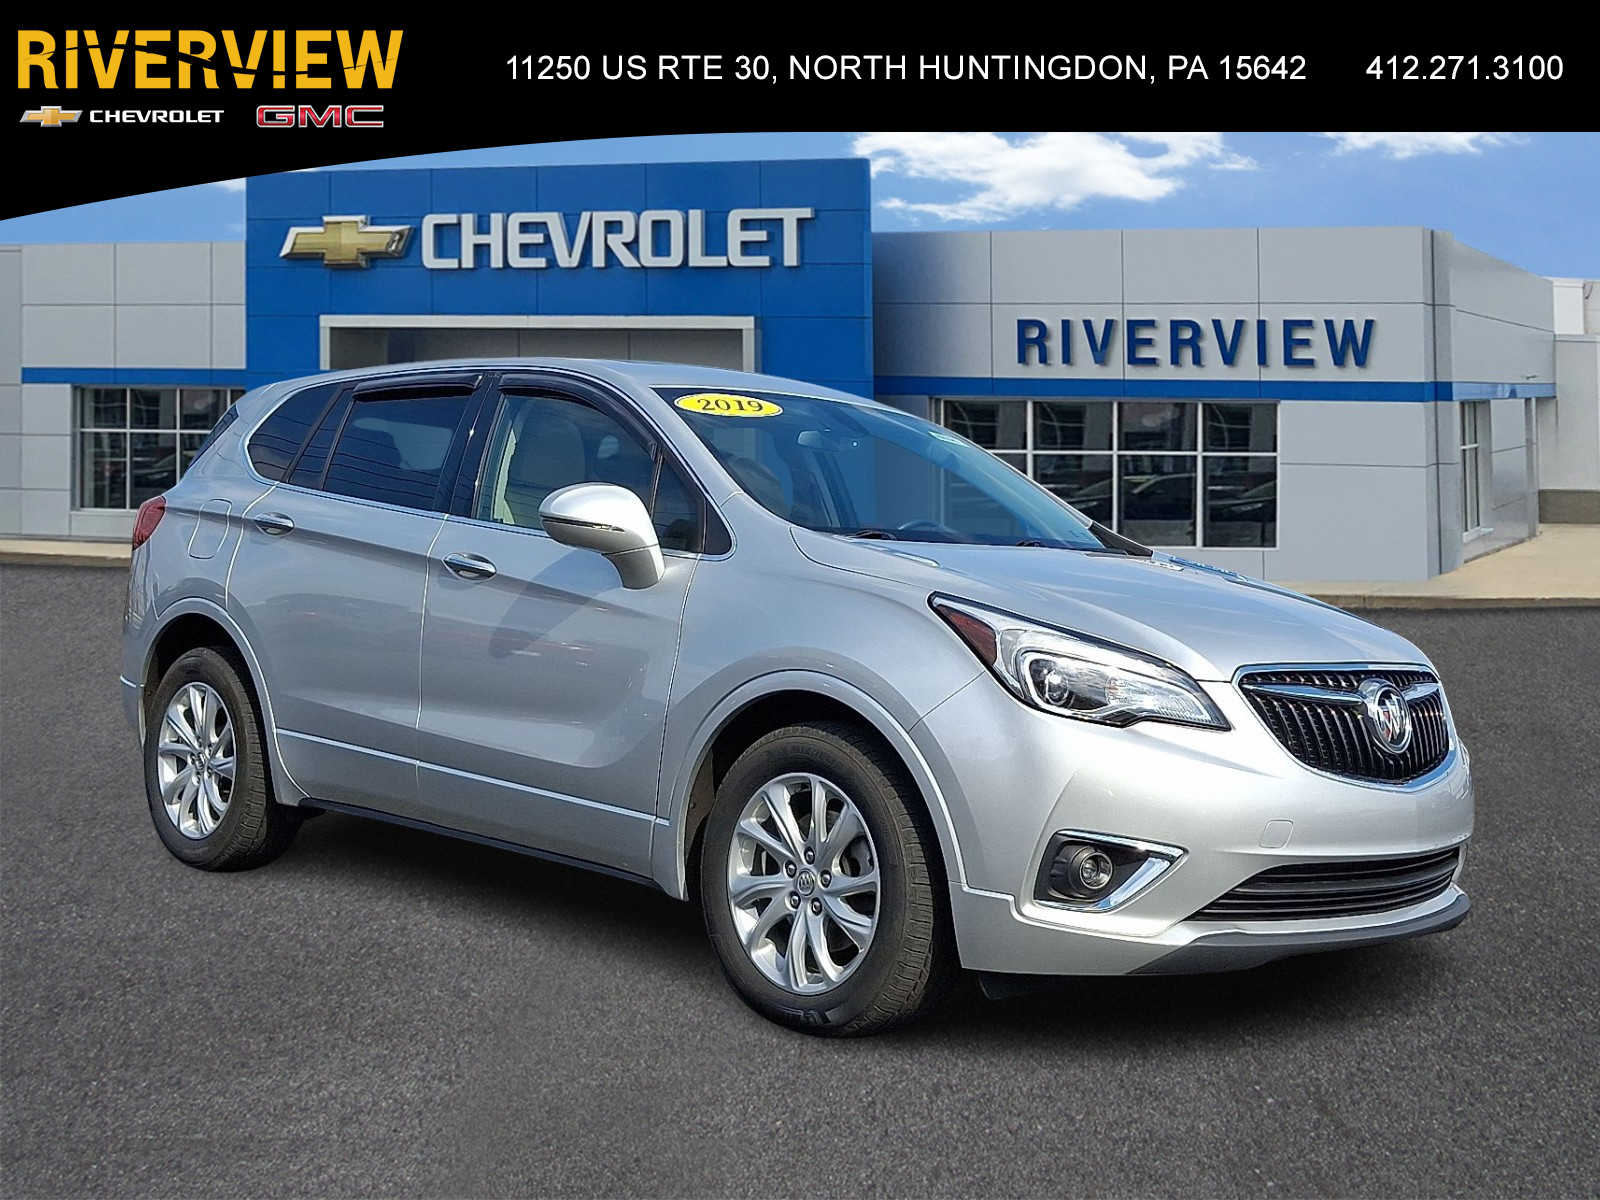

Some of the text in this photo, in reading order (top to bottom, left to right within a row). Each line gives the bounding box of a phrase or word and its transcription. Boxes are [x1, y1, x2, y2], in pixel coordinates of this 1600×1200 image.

[421, 207, 814, 269] CHEVROLET
[1016, 318, 1376, 368] RIVERVIEW
[697, 397, 764, 413] 2019
